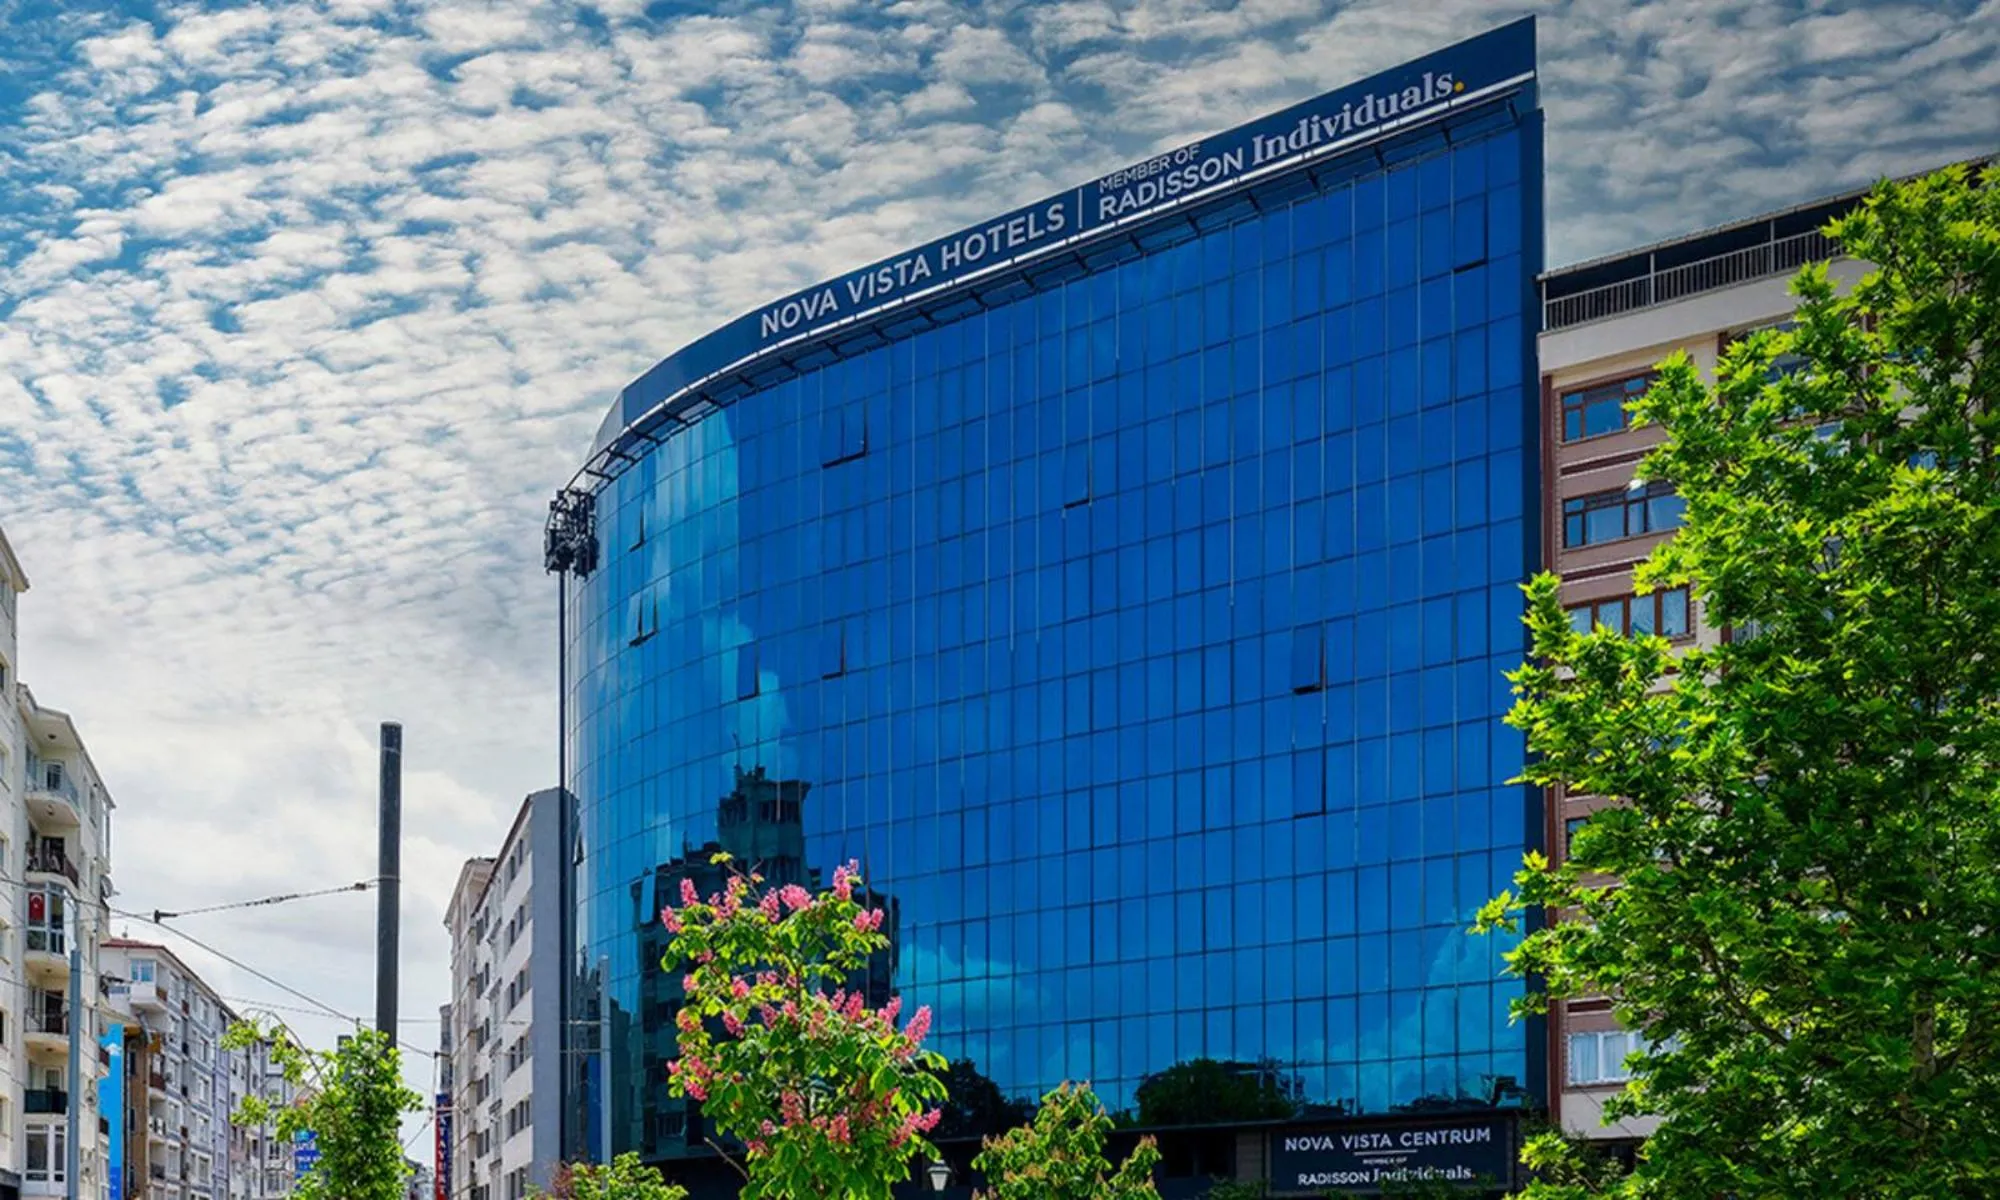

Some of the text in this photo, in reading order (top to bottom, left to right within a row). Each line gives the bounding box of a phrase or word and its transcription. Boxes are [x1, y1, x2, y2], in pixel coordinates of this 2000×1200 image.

[1099, 72, 1465, 220] RADISSON Individuals.
[1099, 144, 1201, 193] MEMBER OF
[761, 203, 1065, 338] NOVA VISTA HOTELS
[1285, 1127, 1491, 1152] NOVA VISTA CENTRUM
[1297, 1171, 1370, 1186] RADISSON
